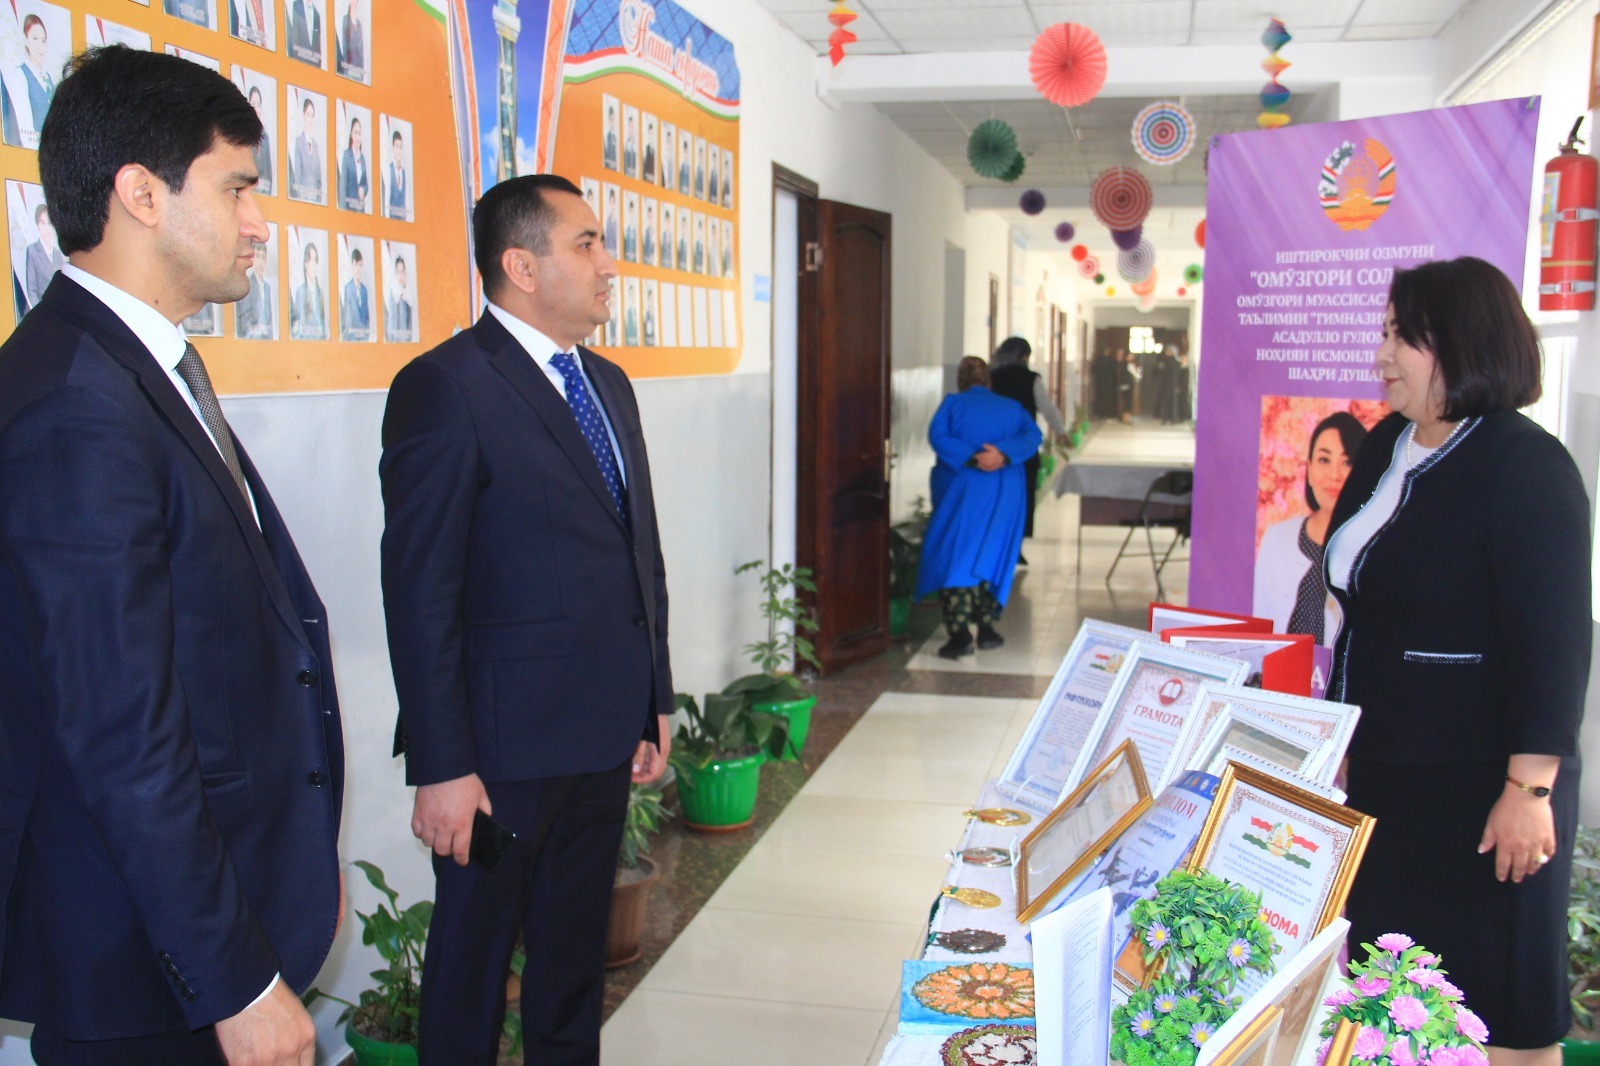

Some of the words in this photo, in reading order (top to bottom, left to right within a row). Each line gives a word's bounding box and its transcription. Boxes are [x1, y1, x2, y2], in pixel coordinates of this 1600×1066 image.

[1372, 245, 1435, 260] ОЗМУНИ
[1272, 331, 1339, 345] АСАДУЛЛО
[1133, 704, 1184, 729] ГРАМОТА
